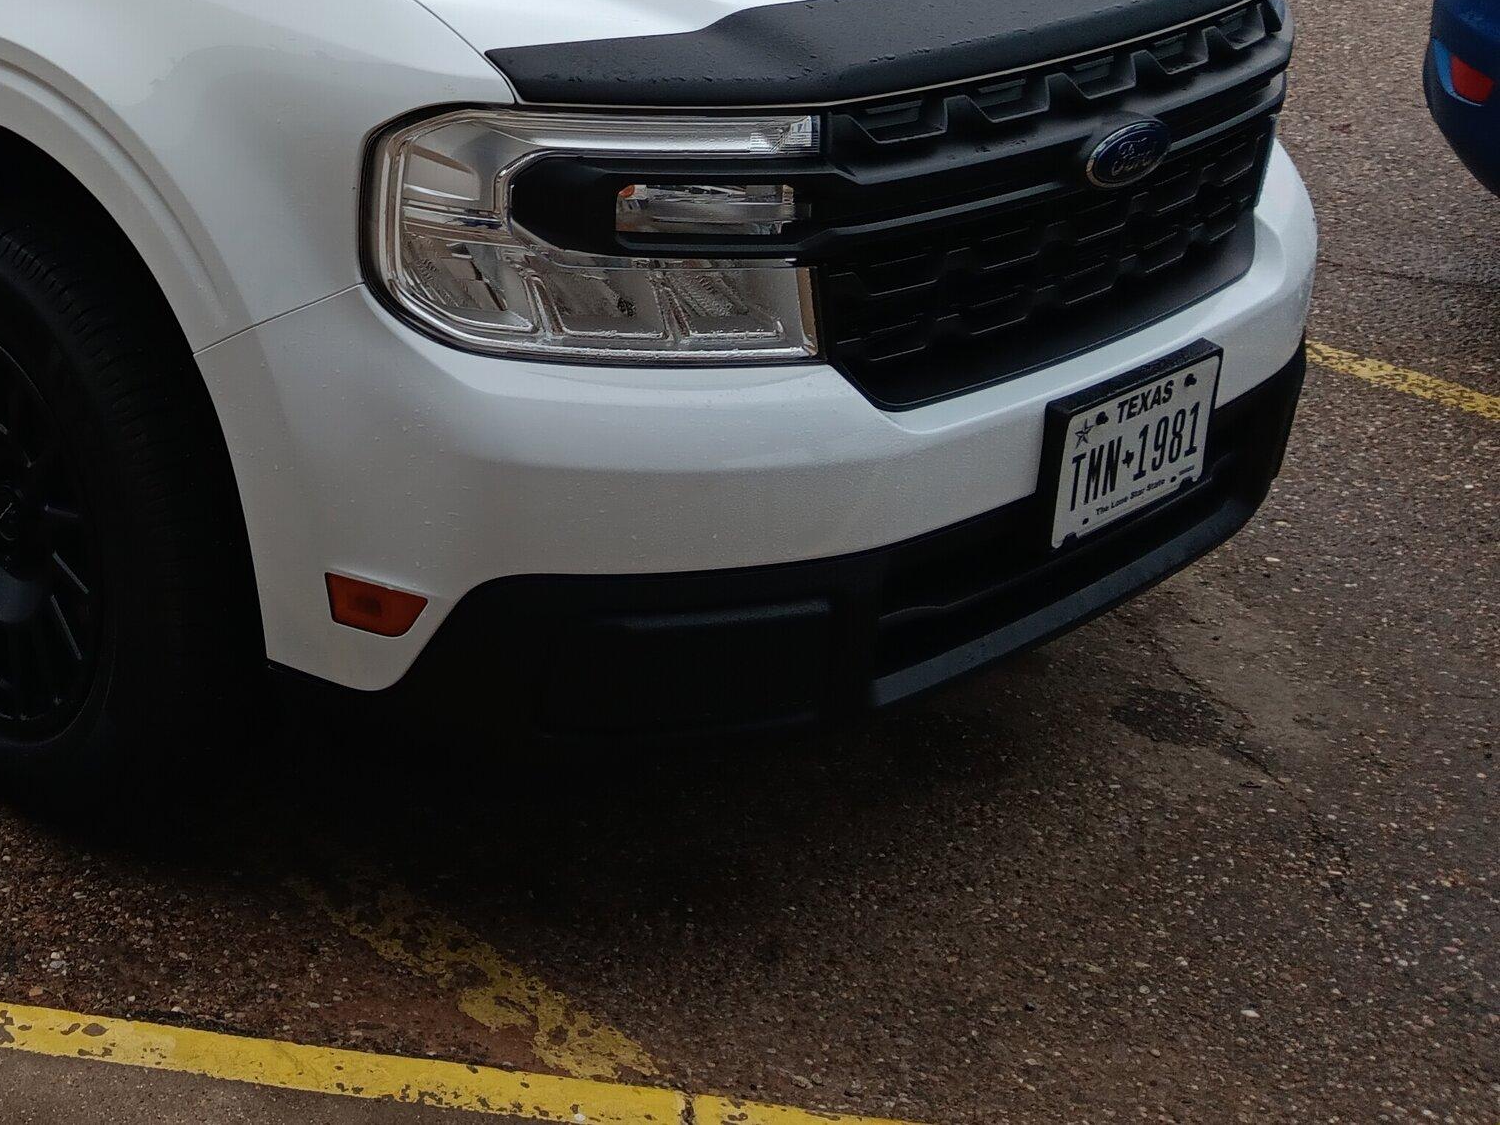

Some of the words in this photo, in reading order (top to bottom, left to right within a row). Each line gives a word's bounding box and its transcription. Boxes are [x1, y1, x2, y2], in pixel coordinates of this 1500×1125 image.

[1117, 380, 1174, 423] TEXAS
[1096, 506, 1110, 515] The
[1110, 496, 1129, 509] Lone
[1130, 488, 1146, 500] Star
[1146, 478, 1166, 492] State
